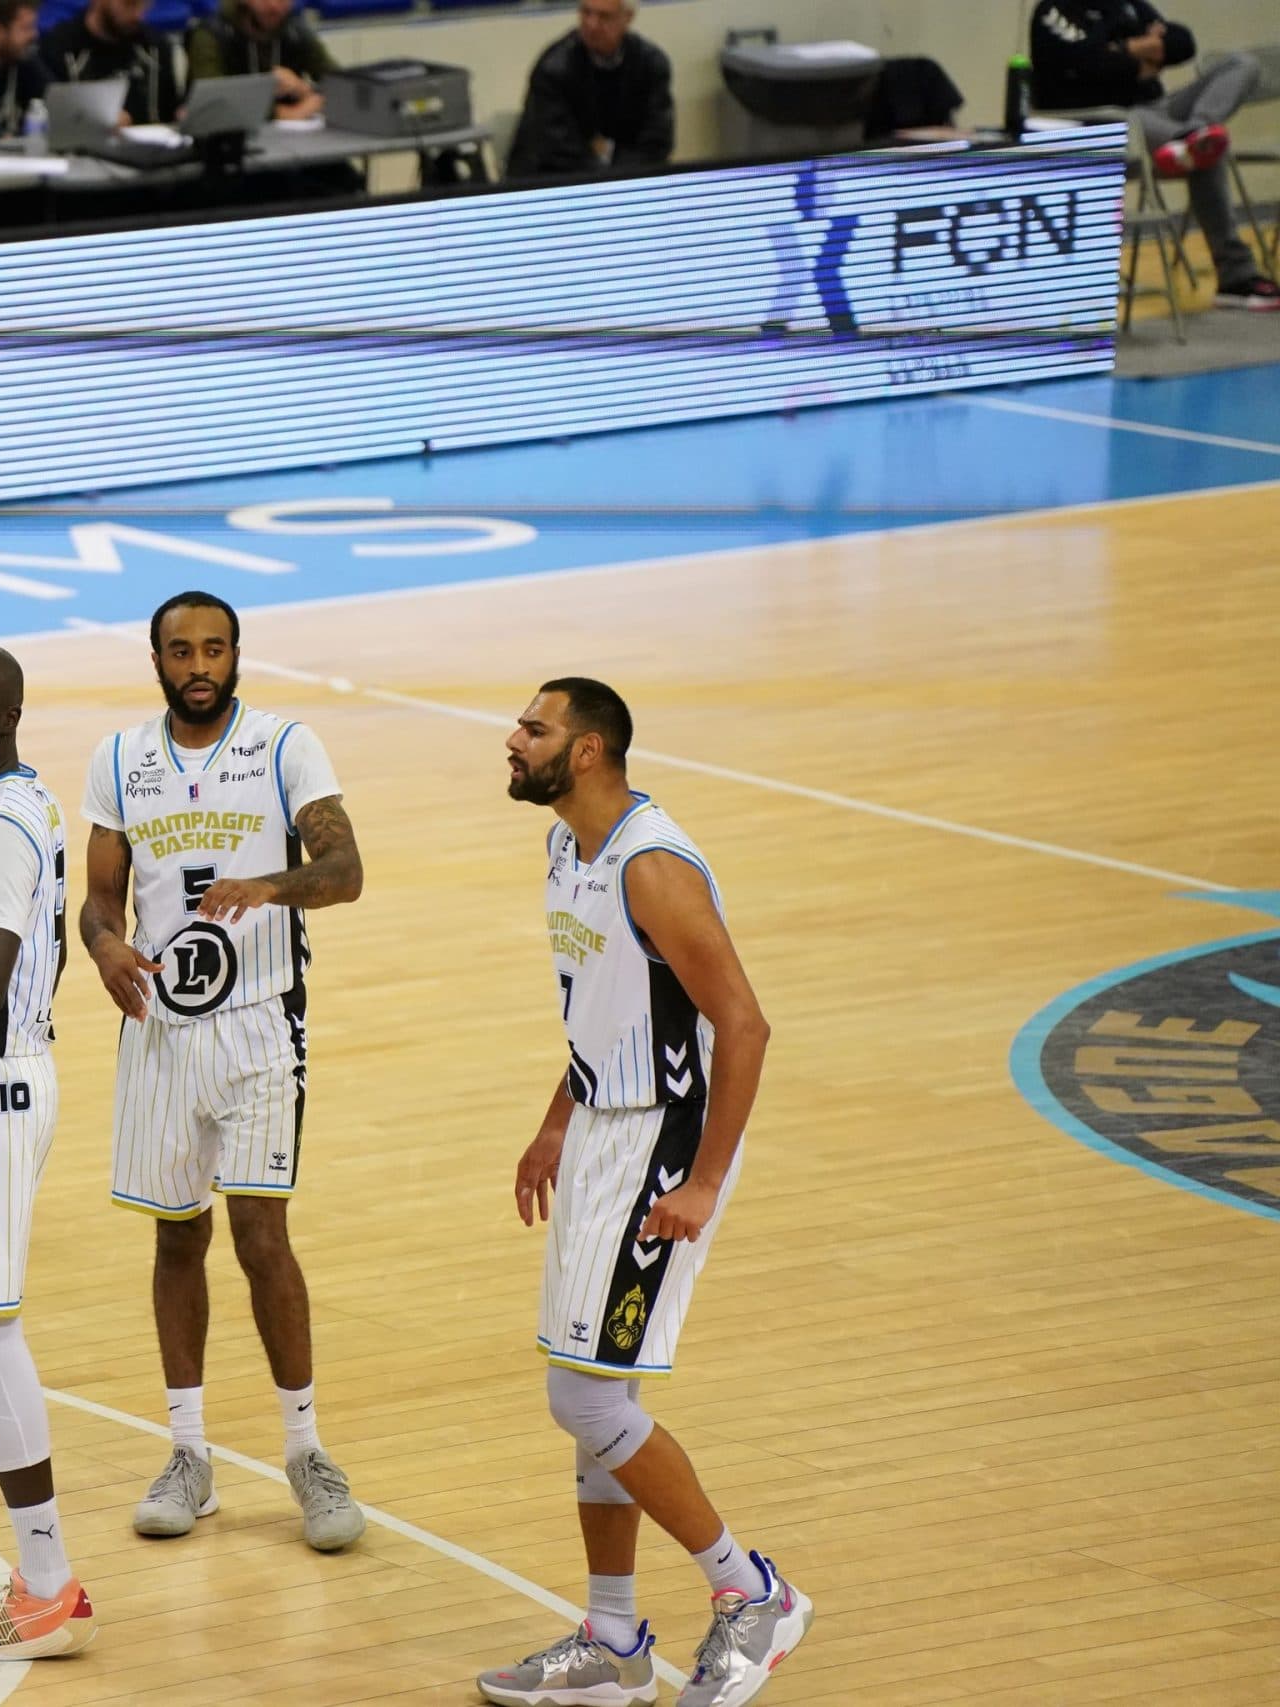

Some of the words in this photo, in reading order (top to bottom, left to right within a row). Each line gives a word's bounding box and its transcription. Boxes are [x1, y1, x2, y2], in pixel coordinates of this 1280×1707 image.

[126, 811, 265, 846] CHAMPAGNE
[150, 832, 243, 860] BASKET
[182, 865, 217, 914] 5
